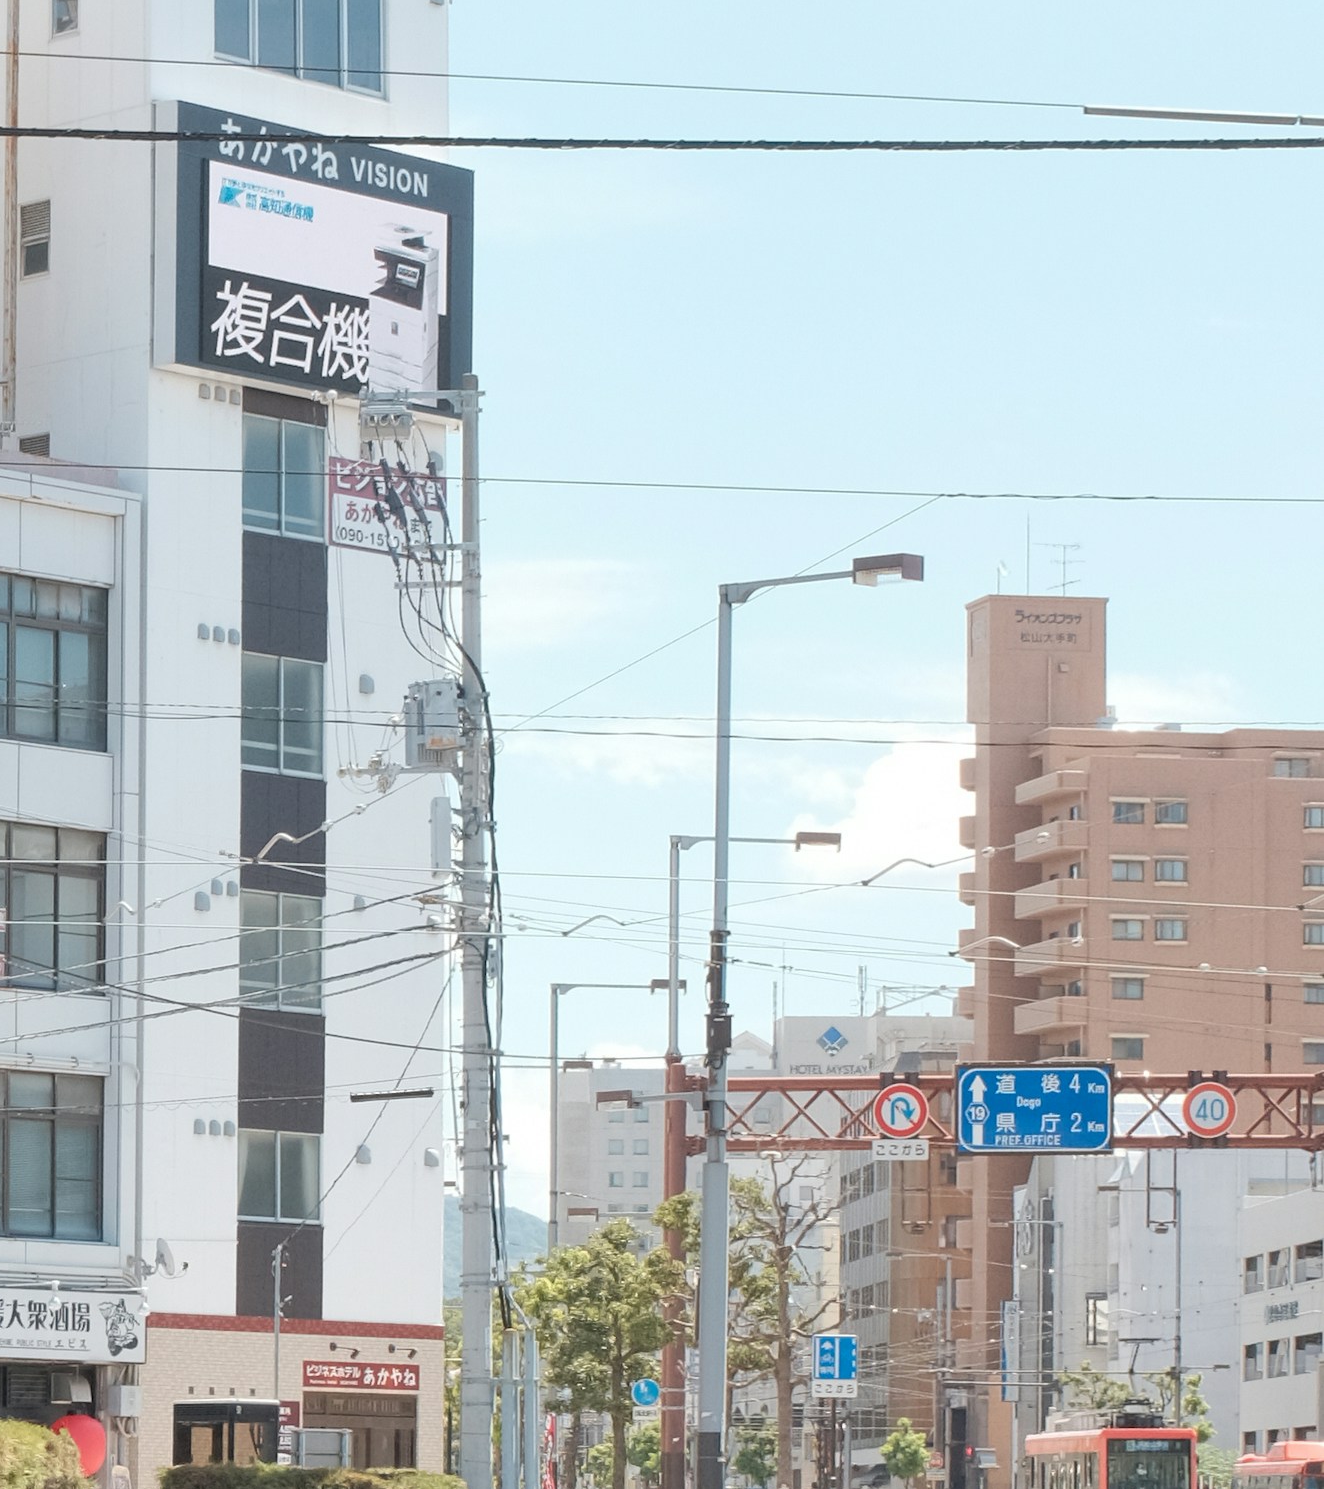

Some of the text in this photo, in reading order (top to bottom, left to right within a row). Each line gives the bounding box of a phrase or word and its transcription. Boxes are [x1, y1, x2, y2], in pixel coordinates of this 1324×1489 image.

[218, 118, 429, 197] あかやね VISION
[211, 280, 370, 384] 複合機
[790, 1065, 822, 1075] HOTEL
[1069, 1074, 1080, 1094] 4
[970, 1106, 985, 1120] 19
[1016, 1096, 1042, 1110] Dogo
[1195, 1099, 1225, 1121] 40
[1071, 1113, 1082, 1133] 2
[876, 1144, 925, 1156] ここから
[54, 1338, 87, 1349] エビス
[306, 1364, 361, 1378] ビジネスホテル
[363, 1367, 416, 1387] あかやね
